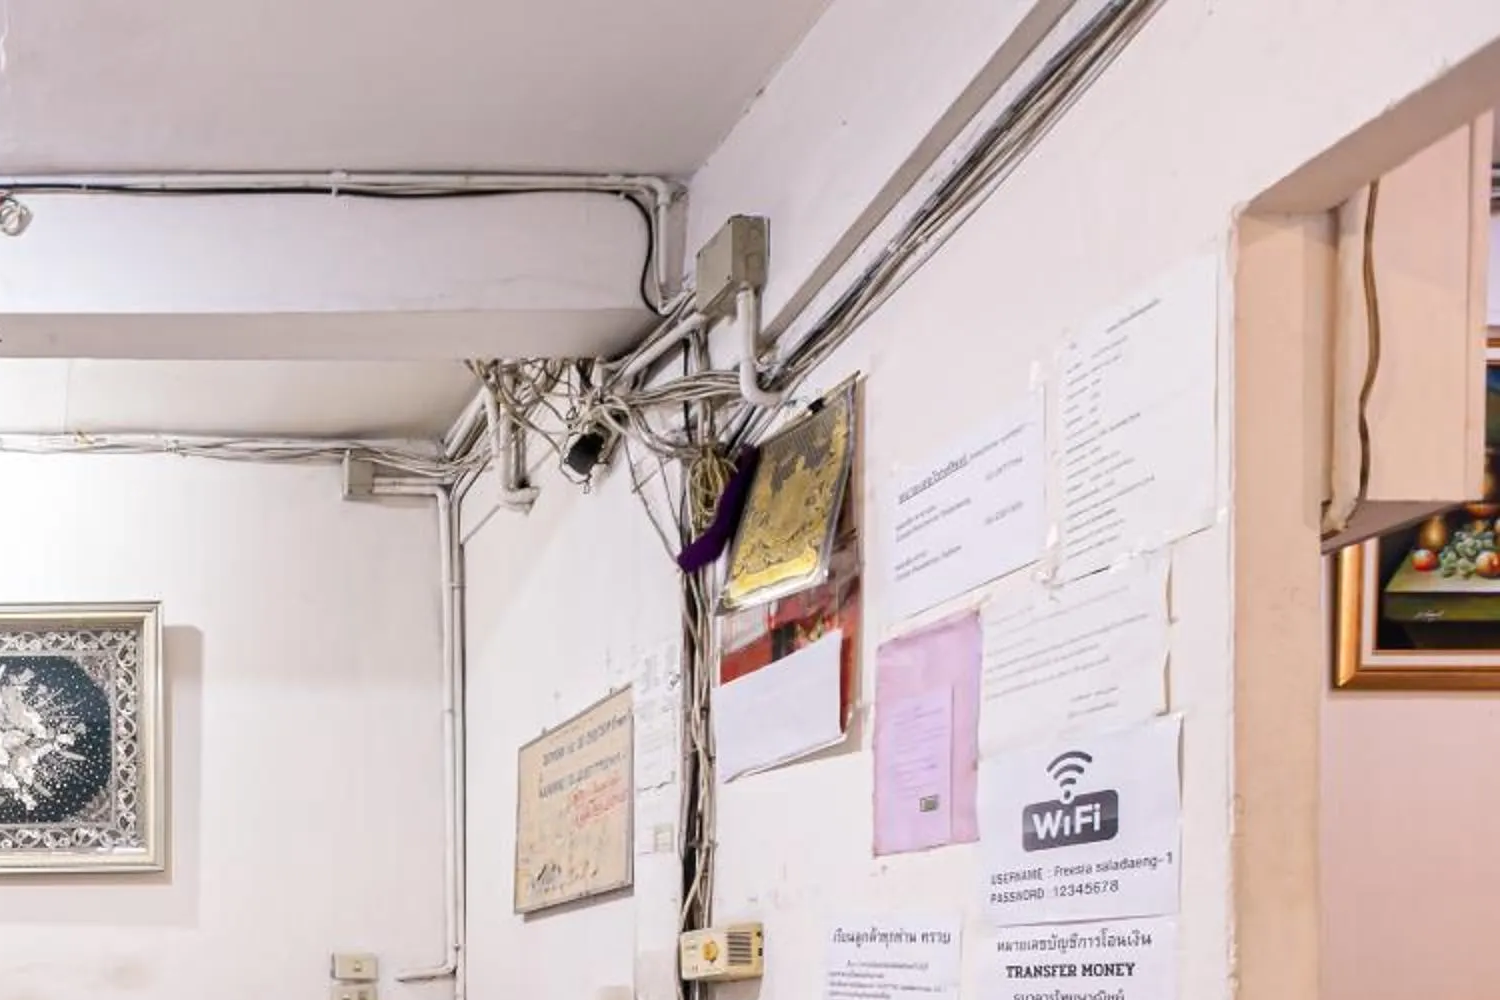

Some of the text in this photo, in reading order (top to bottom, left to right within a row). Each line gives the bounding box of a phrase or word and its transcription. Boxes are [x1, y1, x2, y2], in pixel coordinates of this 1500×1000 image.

[1032, 803, 1101, 840] WiFi
[991, 866, 1043, 886] USERNAME
[1053, 879, 1119, 898] 12345678
[1006, 962, 1136, 979] TRANSFER MONEY
